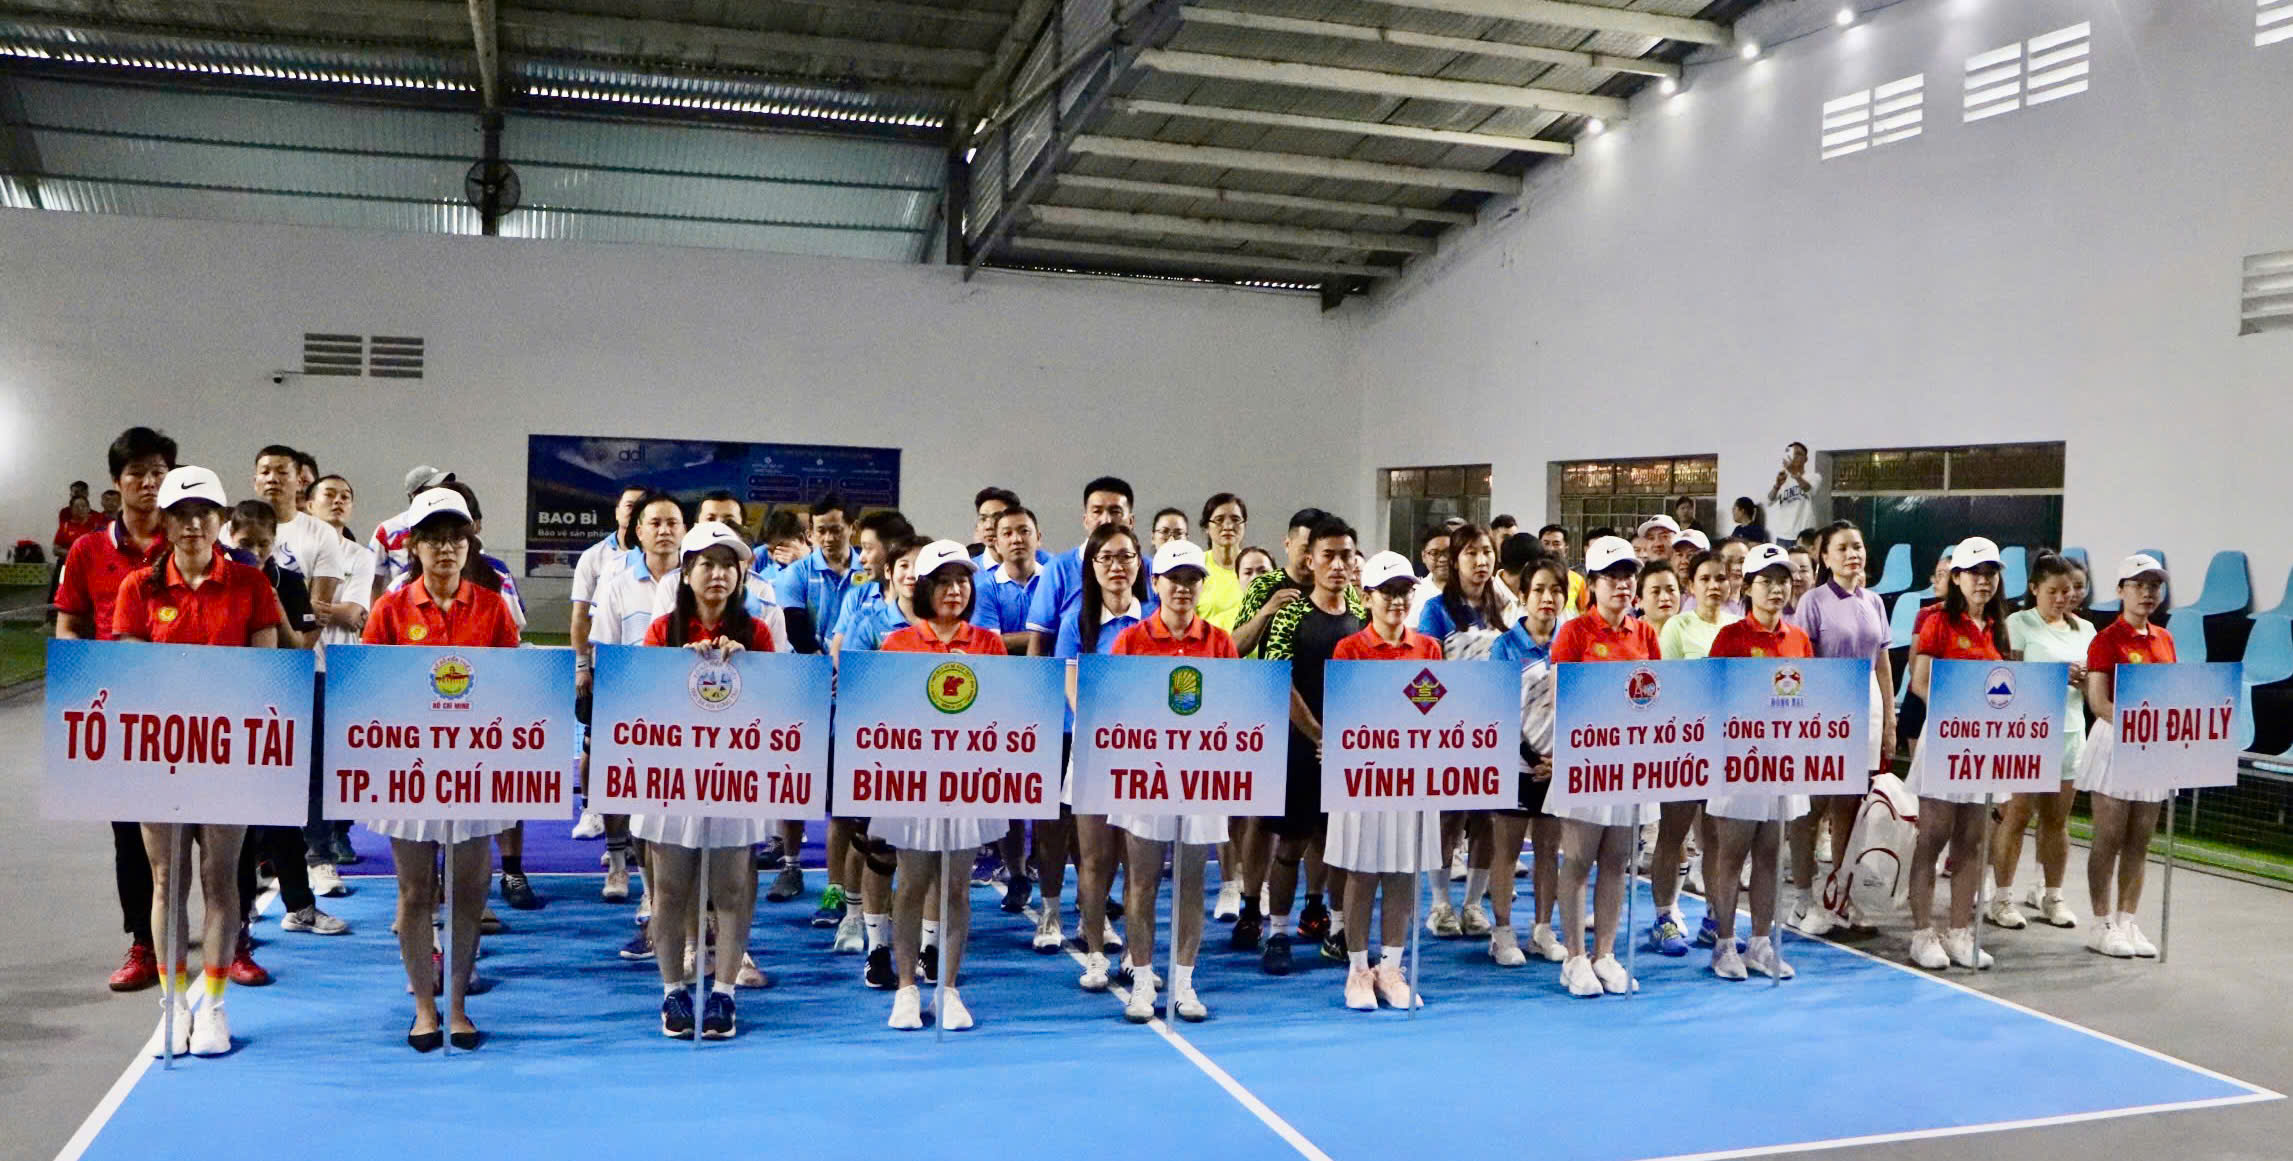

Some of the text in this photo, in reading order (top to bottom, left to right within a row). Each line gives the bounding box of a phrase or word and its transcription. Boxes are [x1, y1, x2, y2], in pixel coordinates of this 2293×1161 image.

[538, 512, 575, 525] BAO
[64, 690, 294, 774] TỔ TRỌNG TÀI
[348, 717, 546, 749] CÔNG TY XỔ SỐ
[614, 718, 802, 752] CÔNG TY XỔ SỐ
[857, 722, 1037, 752] CÔNG TY XỔ SỐ
[1096, 722, 1264, 752] CÔNG TY XỔ SỐ
[1342, 720, 1497, 749] CÔNG TY XỔ SỐ
[1571, 717, 1706, 748] CÔNG TY XỔ SỐ
[1724, 713, 1852, 739] ÔNG TY XỔ SỐ
[1940, 713, 2051, 739] CÔNG TY XỔ SỐ
[2122, 700, 2232, 750] HỘI ĐẠI LÝ
[336, 758, 560, 803] TP. HỒ CHÍ MINH
[1110, 762, 1252, 800] TRÀ VINH
[1344, 762, 1499, 797] VĨNH LONG
[1569, 753, 1709, 794] BÌNH PHƯỚC
[1724, 746, 1844, 782] ĐỒNG NAI
[1948, 748, 2041, 780] TÂY NINH
[607, 758, 811, 807] BÀ RỊA VŨNG TÀU
[853, 762, 1042, 804] BÌNH DƯƠNG
